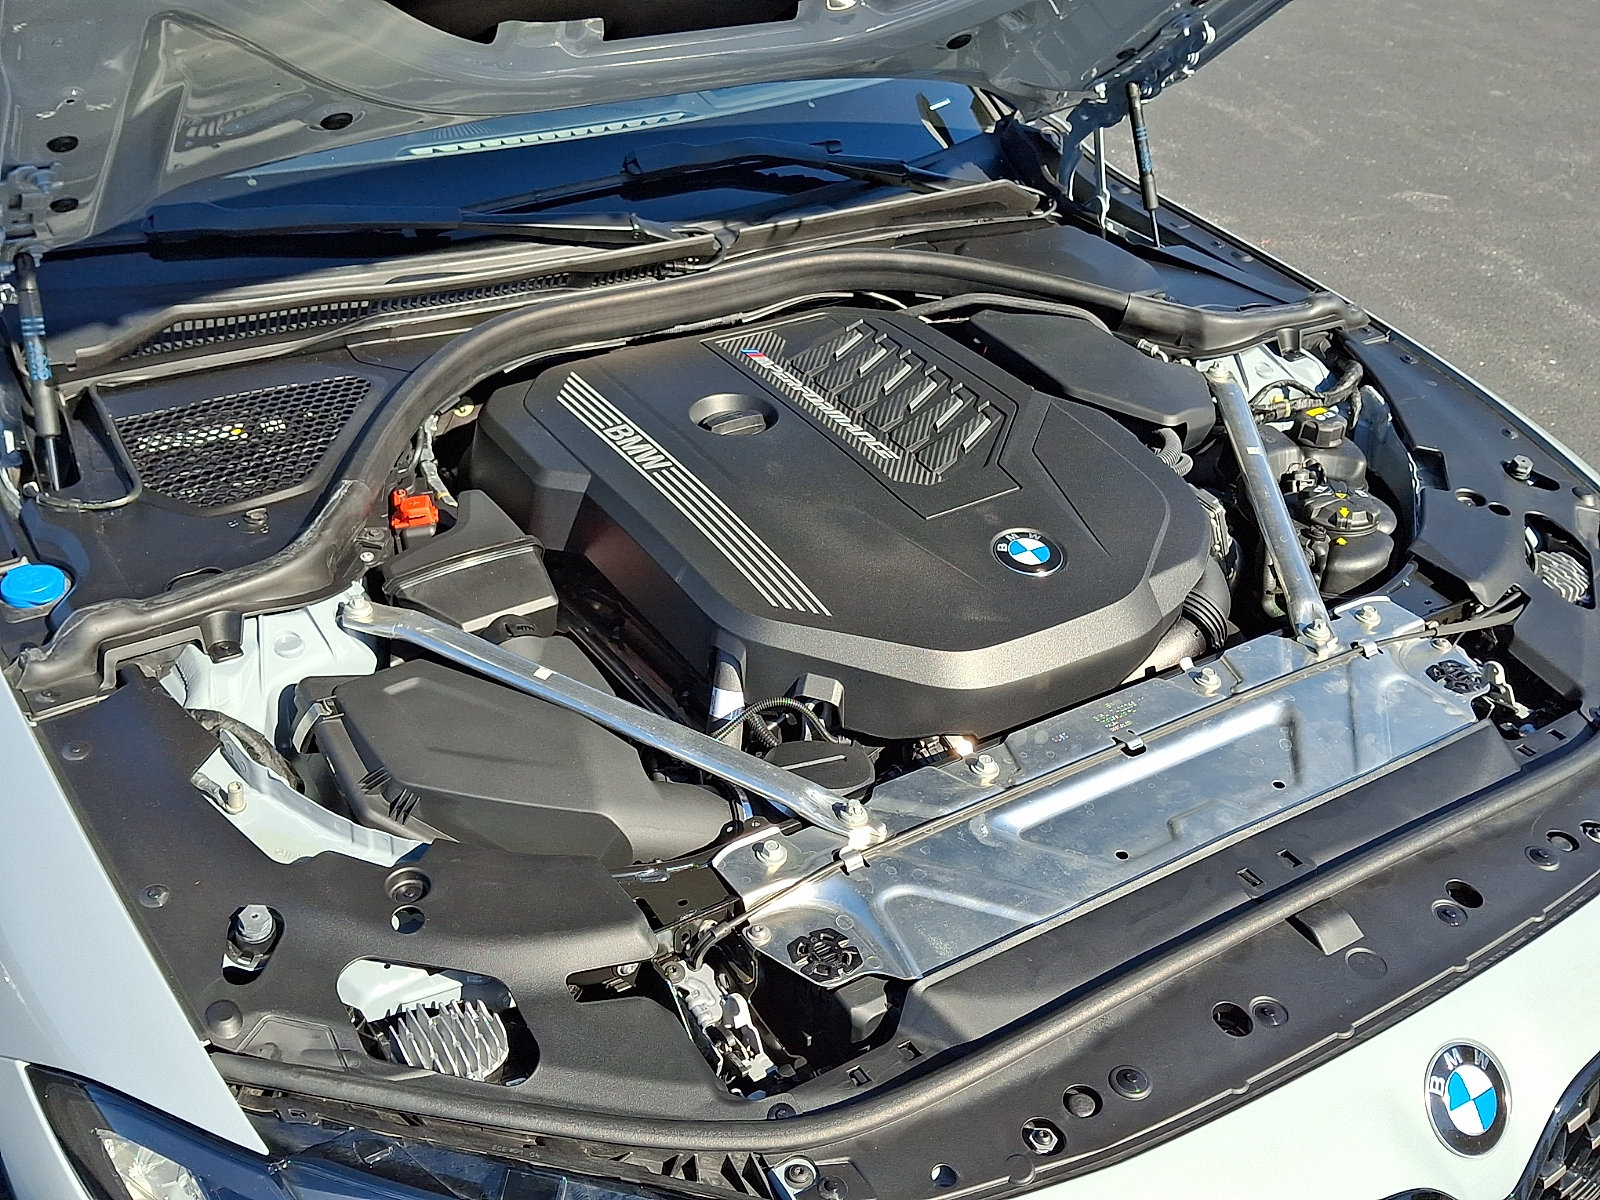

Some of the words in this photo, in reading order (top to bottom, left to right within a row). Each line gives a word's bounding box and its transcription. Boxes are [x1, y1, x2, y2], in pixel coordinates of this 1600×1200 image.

[764, 364, 900, 460] PERFORMANCE
[603, 424, 673, 470] BMW
[997, 532, 1042, 552] BMW
[1429, 1048, 1490, 1098] BMW
